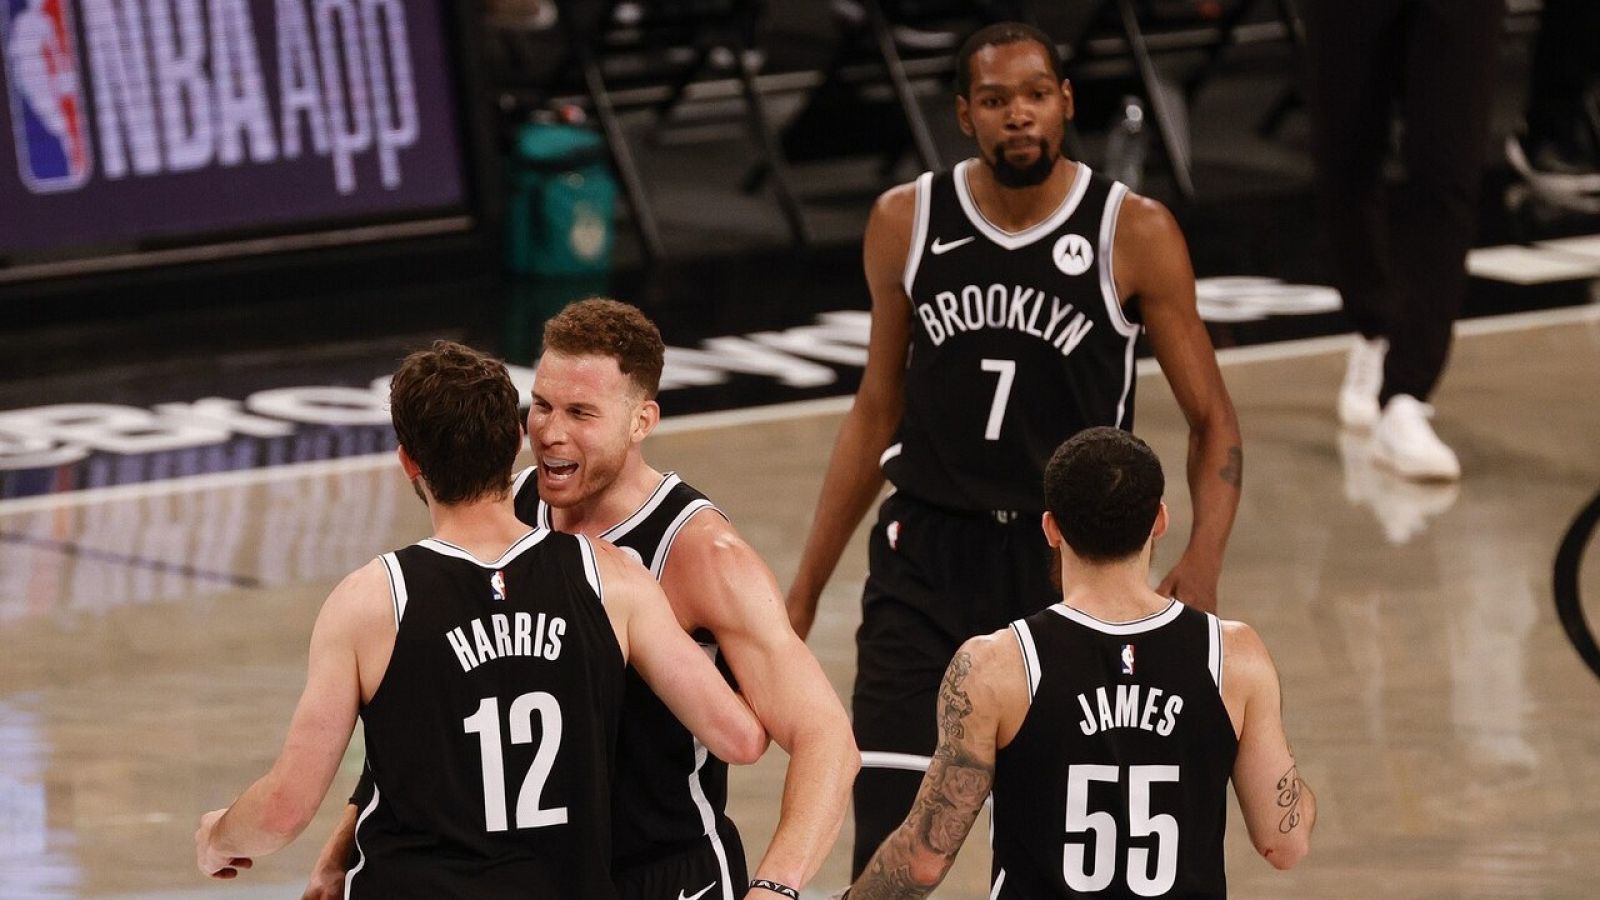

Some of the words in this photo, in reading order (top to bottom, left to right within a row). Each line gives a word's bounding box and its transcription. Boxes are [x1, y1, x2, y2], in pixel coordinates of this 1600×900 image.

[83, 0, 277, 179] NBA
[274, 0, 420, 195] App
[918, 283, 1094, 356] BROOKLYN
[980, 358, 1016, 441] 7
[445, 611, 567, 673] HARRIS
[1077, 684, 1184, 737] JAMES
[463, 691, 569, 832] 12
[1062, 764, 1180, 897] 55
